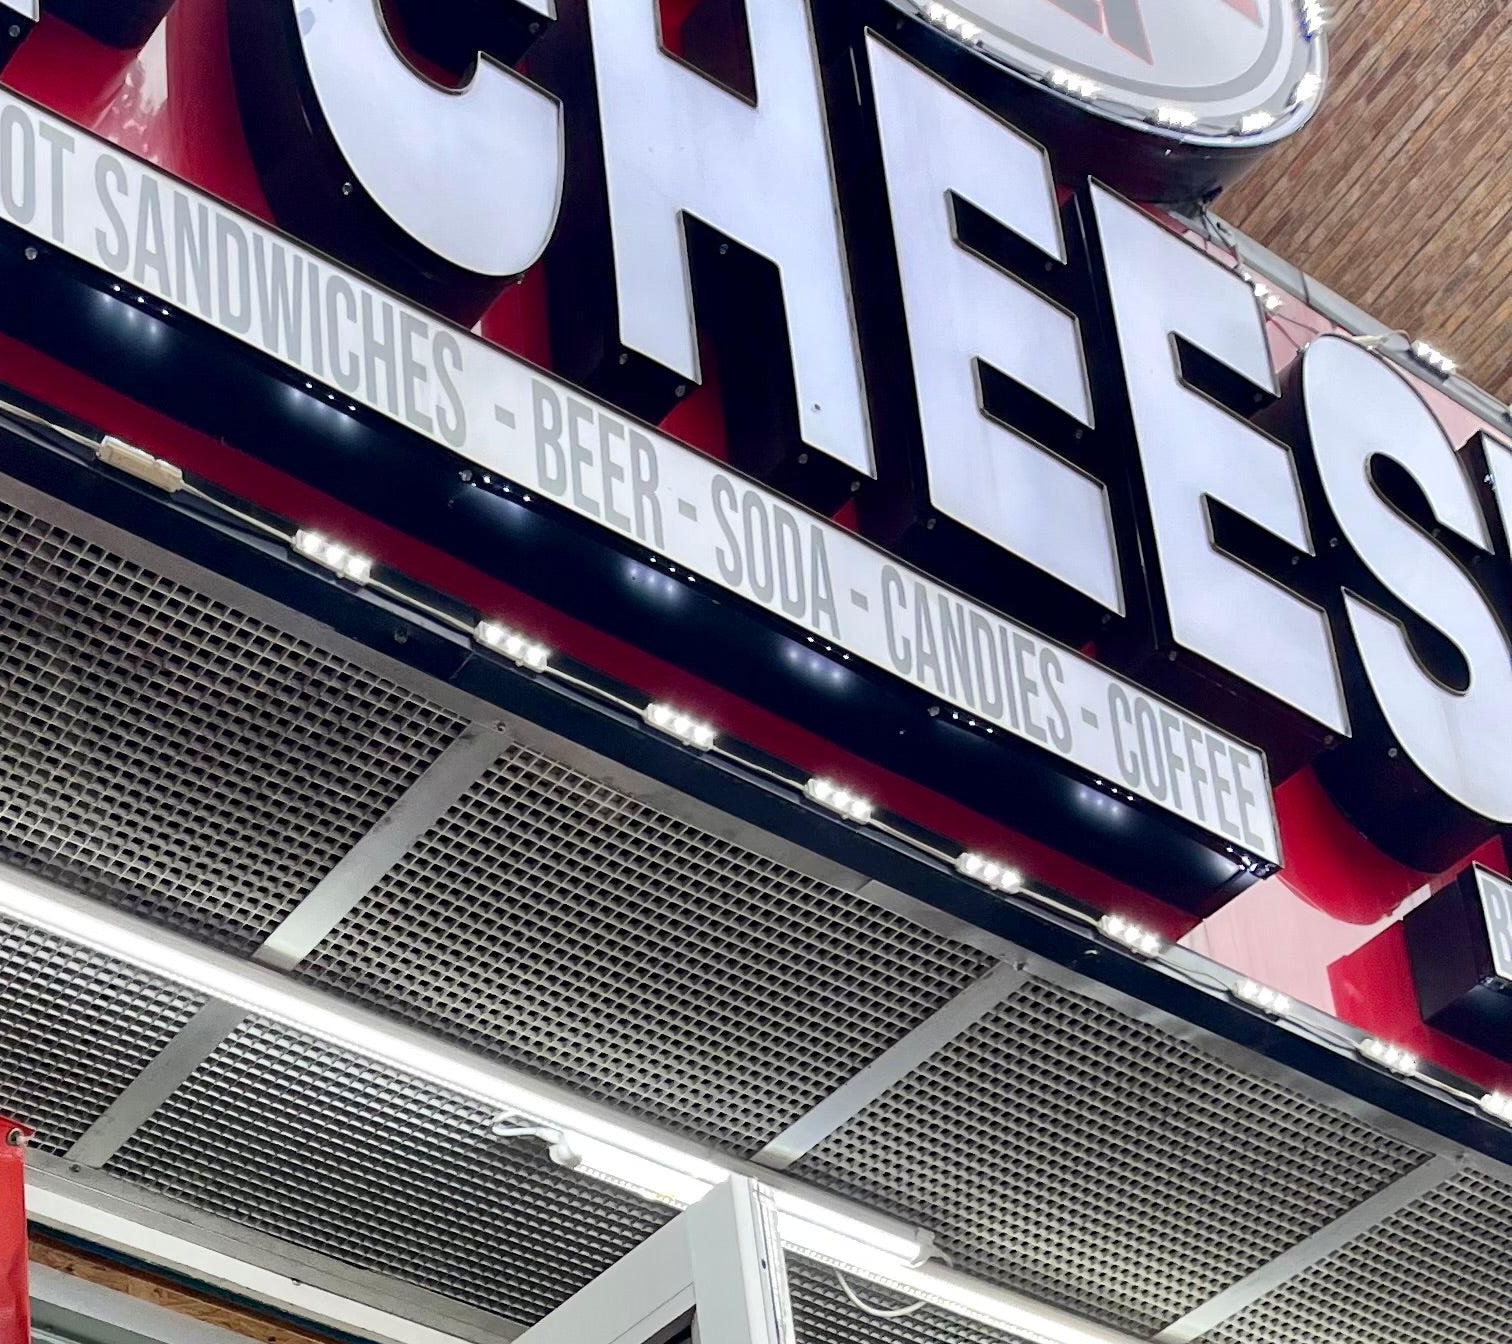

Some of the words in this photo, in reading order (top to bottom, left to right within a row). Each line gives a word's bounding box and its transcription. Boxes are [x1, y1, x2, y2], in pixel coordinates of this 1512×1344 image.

[96, 154, 469, 448] SANDWICHES
[531, 378, 663, 544] BEER
[712, 473, 840, 645] SODA
[883, 564, 1074, 754] CANDIES
[1108, 684, 1267, 853] COFFEE
[294, 0, 1512, 823] CHEES
